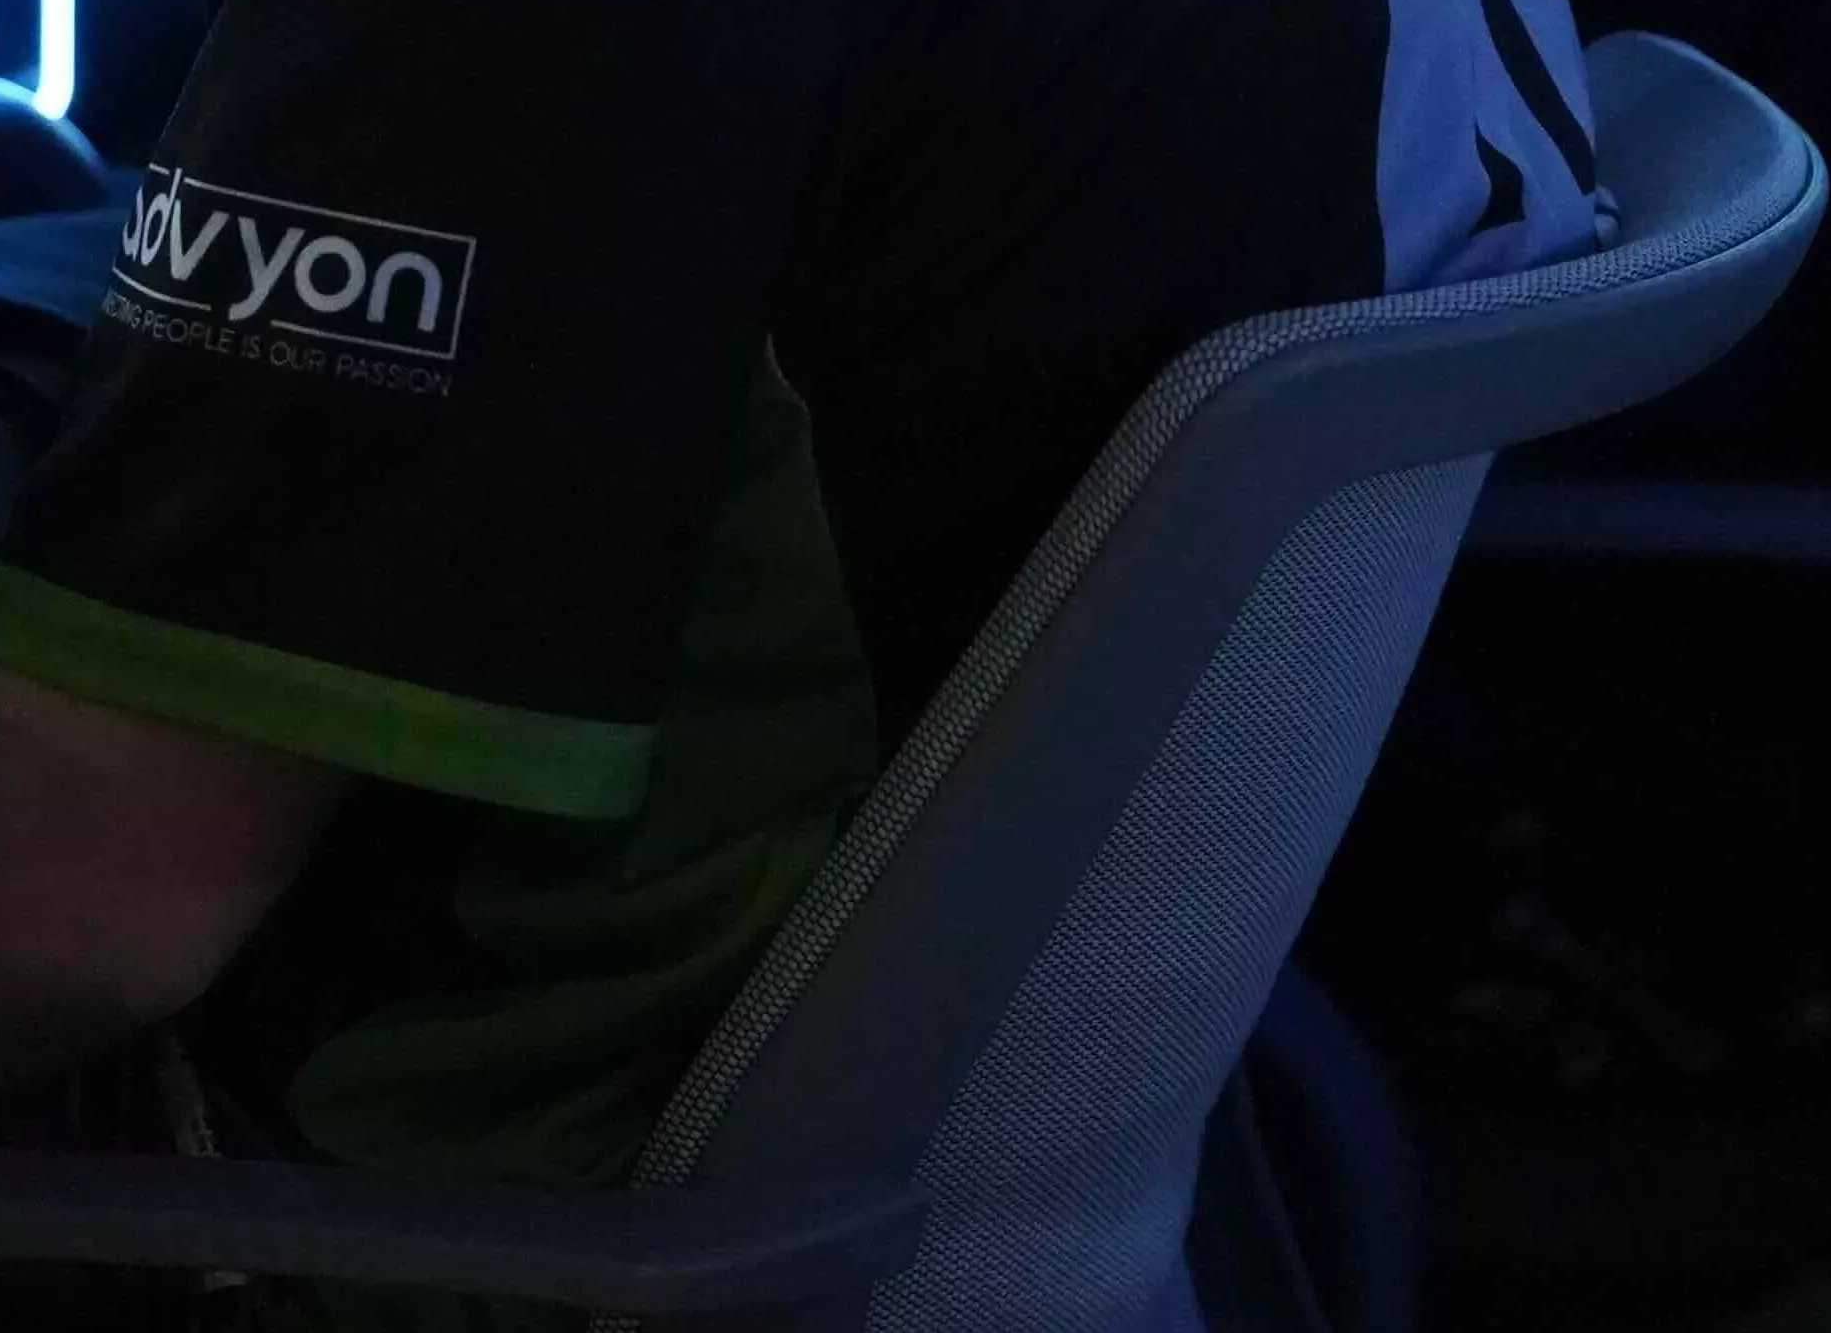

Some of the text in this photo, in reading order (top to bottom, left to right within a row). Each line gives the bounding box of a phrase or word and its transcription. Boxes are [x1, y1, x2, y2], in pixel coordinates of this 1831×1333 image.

[142, 308, 236, 354] PEOPLE
[240, 334, 262, 360] IS
[269, 340, 327, 375] OUR
[334, 352, 453, 397] PASSION
